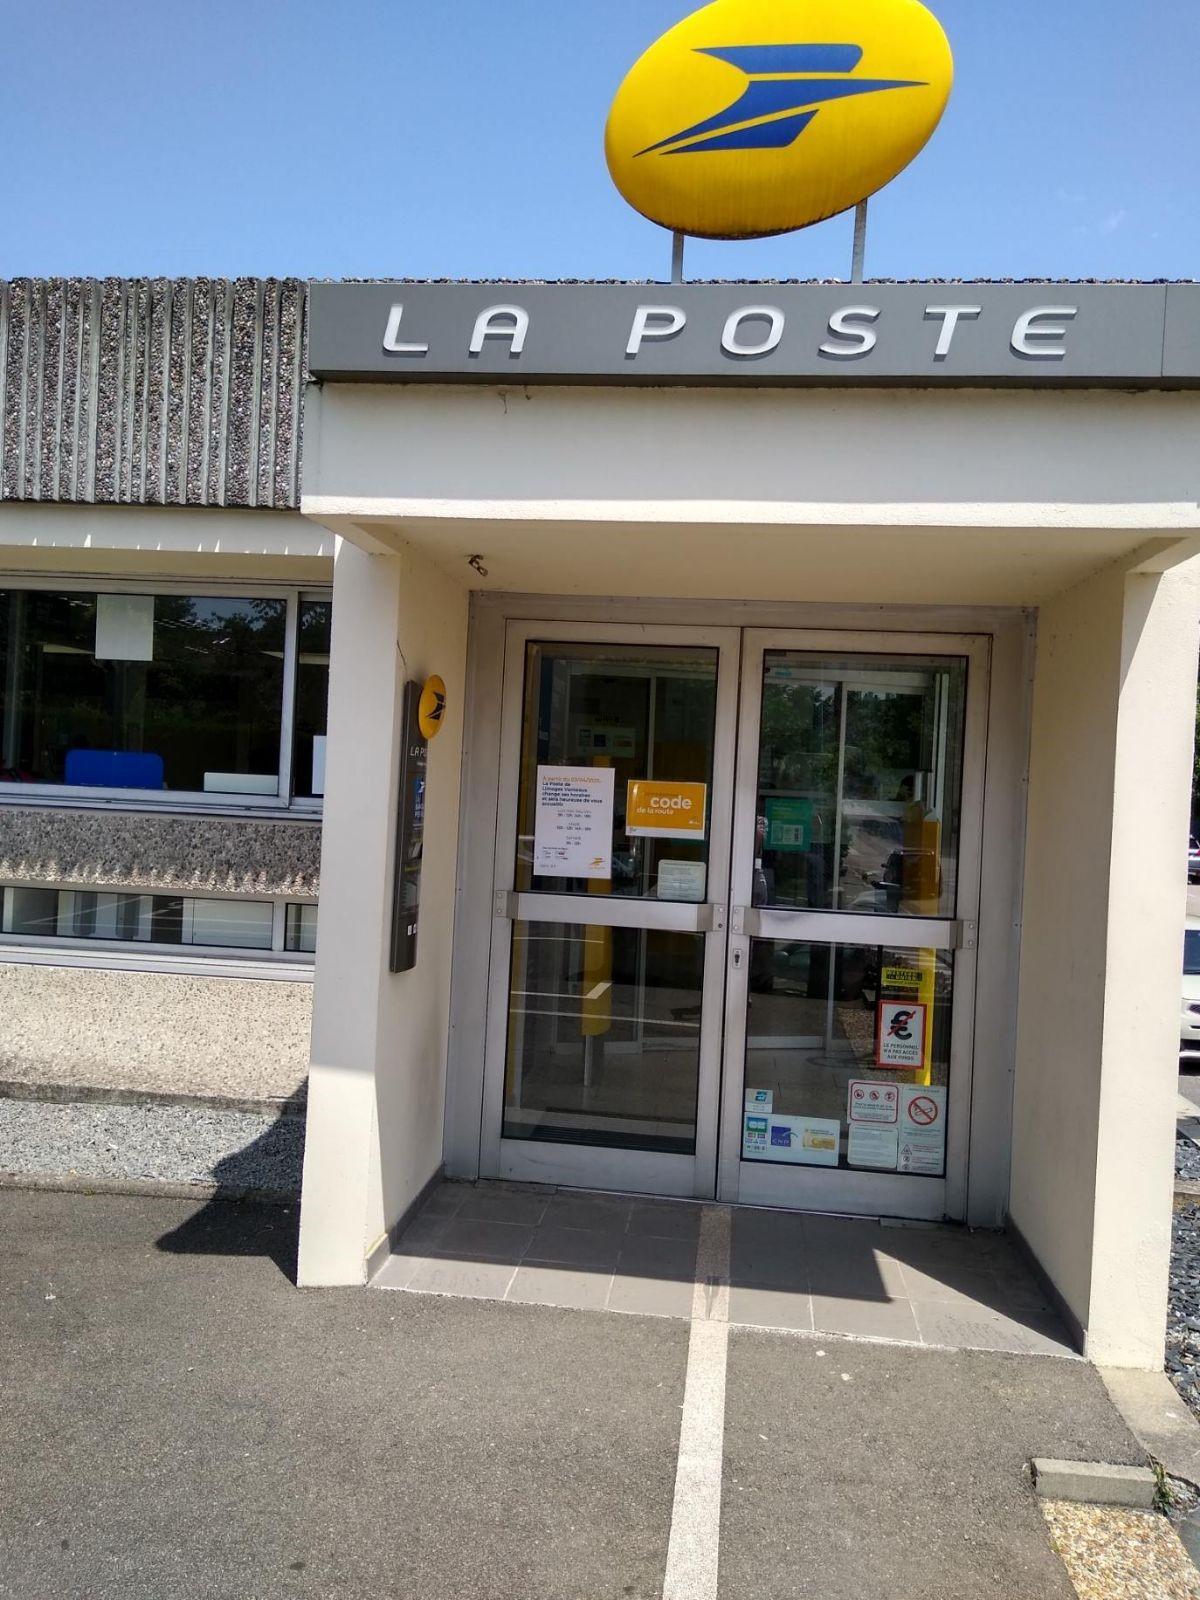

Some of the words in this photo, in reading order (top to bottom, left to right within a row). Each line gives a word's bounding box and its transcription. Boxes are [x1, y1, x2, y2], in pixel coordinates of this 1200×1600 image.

[382, 303, 530, 355] LA
[624, 304, 1078, 357] POSTE
[651, 795, 692, 809] code
[637, 806, 646, 814] de
